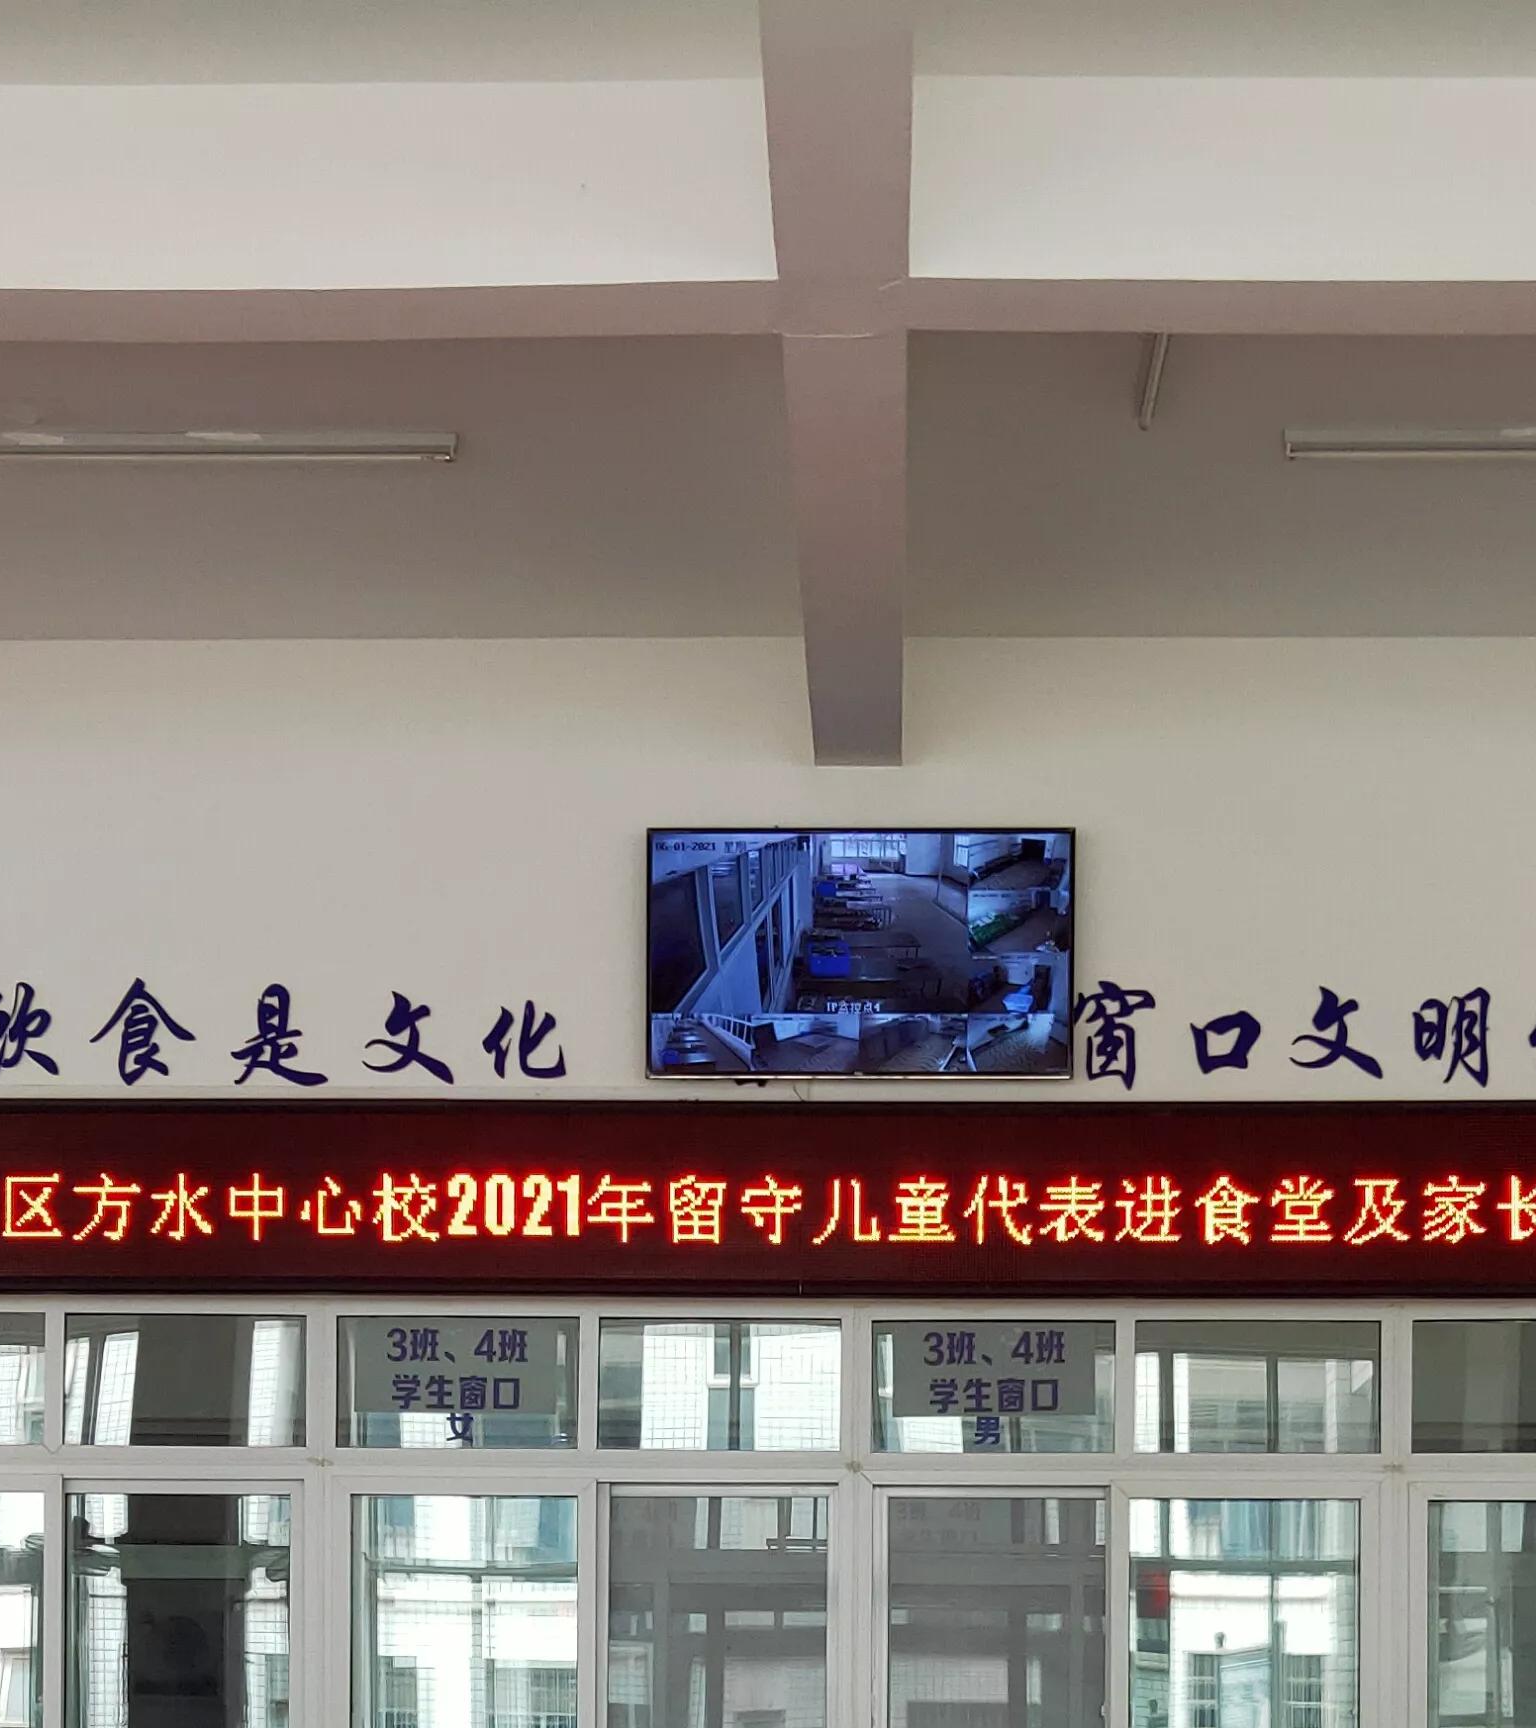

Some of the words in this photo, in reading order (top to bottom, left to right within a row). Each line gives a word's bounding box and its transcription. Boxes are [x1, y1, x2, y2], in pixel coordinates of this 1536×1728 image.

[386, 1328, 529, 1363] 3班、4班
[923, 1330, 1065, 1366] 3班、4班
[392, 1375, 520, 1409] 学生窗口
[930, 1378, 1059, 1413] 学生窗口
[446, 1412, 474, 1443] 女
[974, 1416, 1001, 1445] 男
